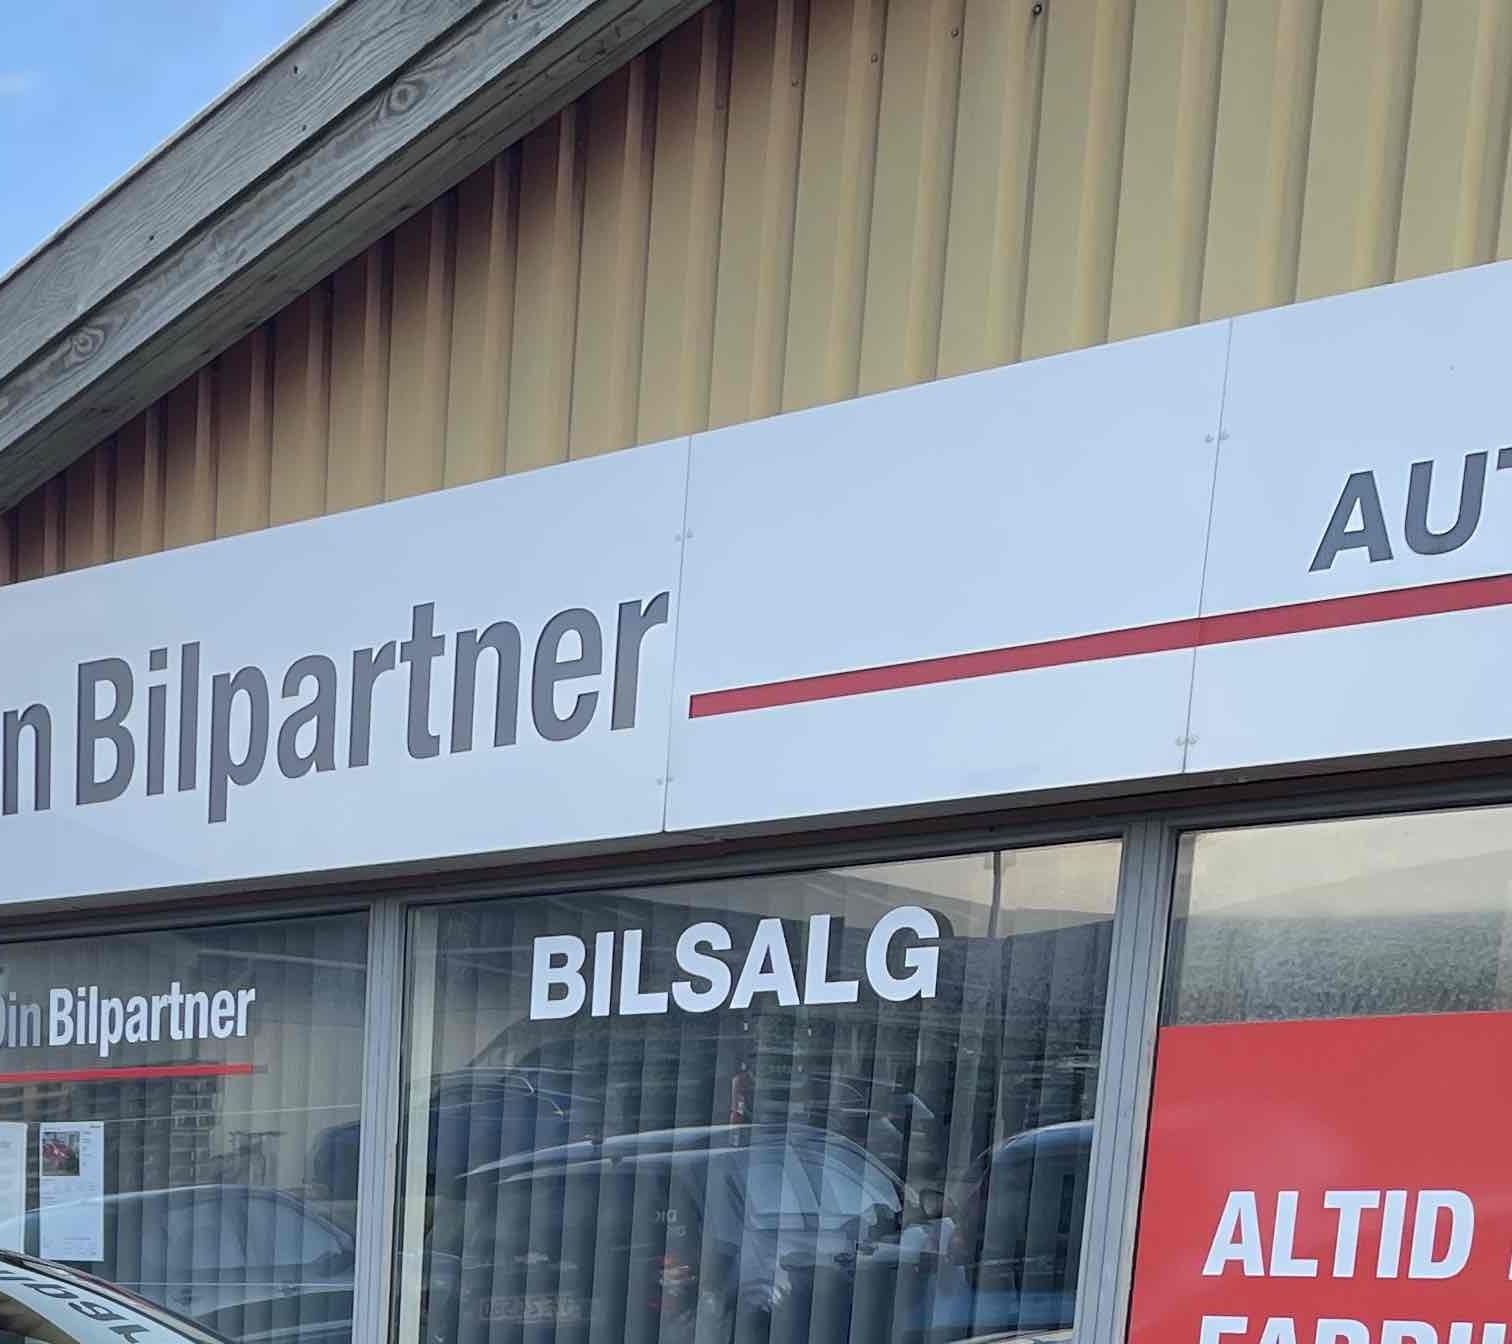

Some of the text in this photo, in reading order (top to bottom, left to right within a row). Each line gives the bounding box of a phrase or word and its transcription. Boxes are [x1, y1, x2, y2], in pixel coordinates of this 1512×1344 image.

[1308, 446, 1512, 572] AU
[75, 591, 669, 825] Bilpartner
[48, 982, 255, 1057] Bilpartner
[529, 905, 941, 1021] BILSALG
[1202, 1190, 1475, 1280] ALTID
